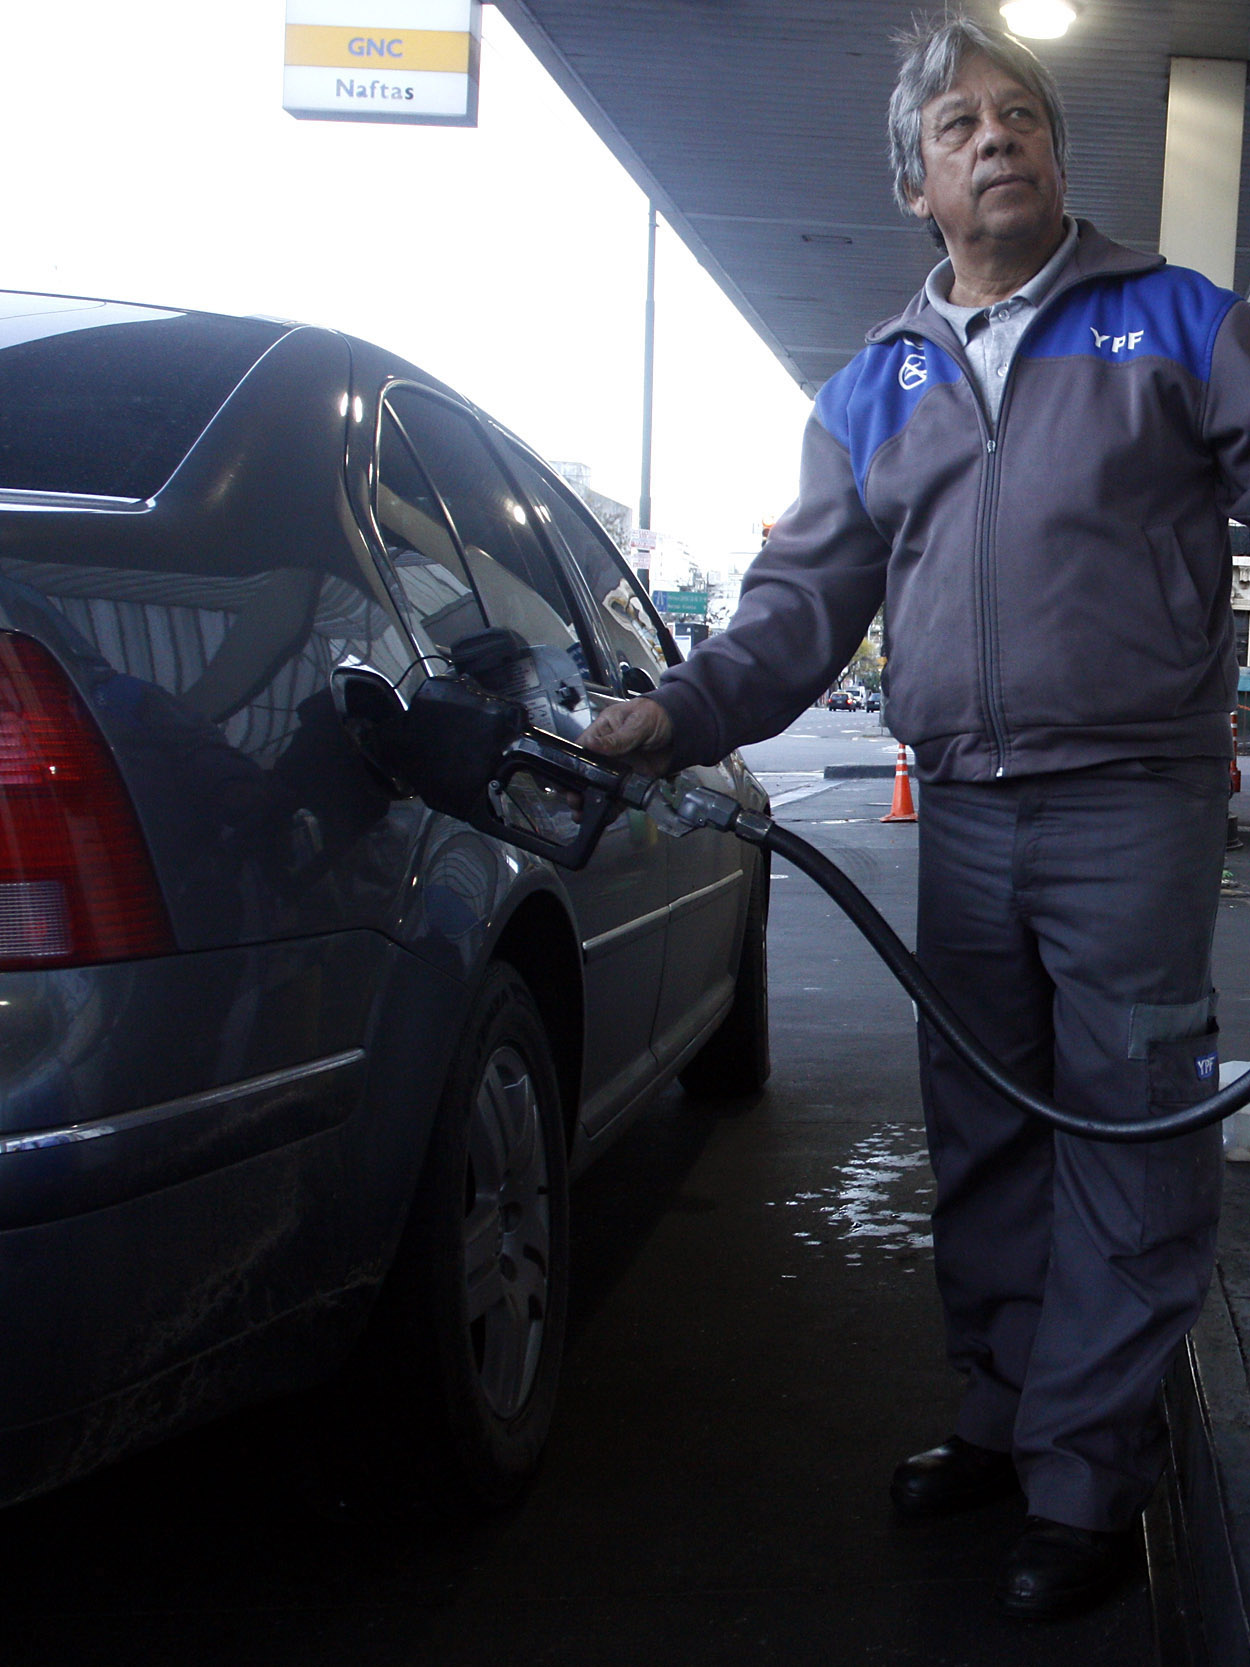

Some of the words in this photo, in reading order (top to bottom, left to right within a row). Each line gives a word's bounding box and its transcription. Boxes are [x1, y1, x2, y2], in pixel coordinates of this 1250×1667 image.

[348, 37, 404, 58] GNC
[336, 79, 414, 100] Naftas
[1090, 327, 1144, 353] YPF
[1197, 1056, 1215, 1076] YPF
